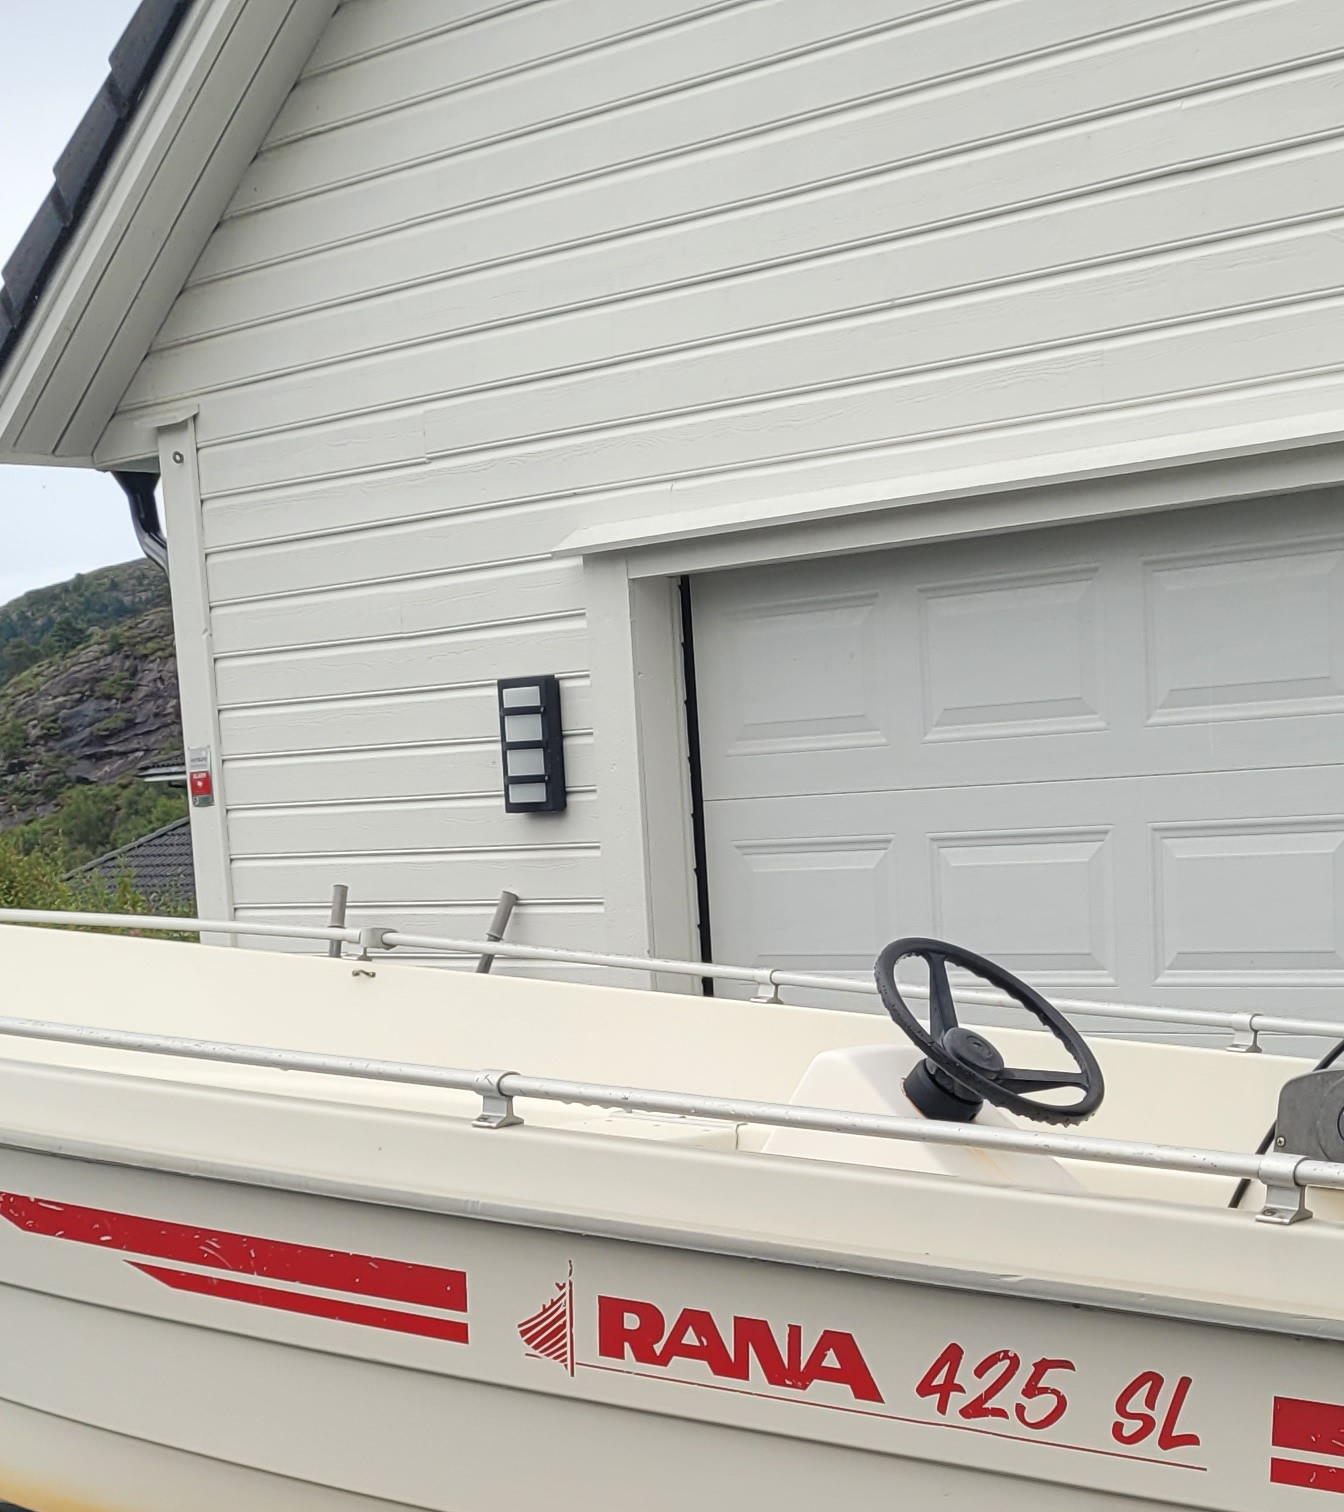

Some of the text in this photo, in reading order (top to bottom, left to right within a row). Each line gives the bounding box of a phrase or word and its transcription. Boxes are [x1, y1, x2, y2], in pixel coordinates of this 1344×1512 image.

[598, 1295, 1200, 1449] RANA 425 SL
